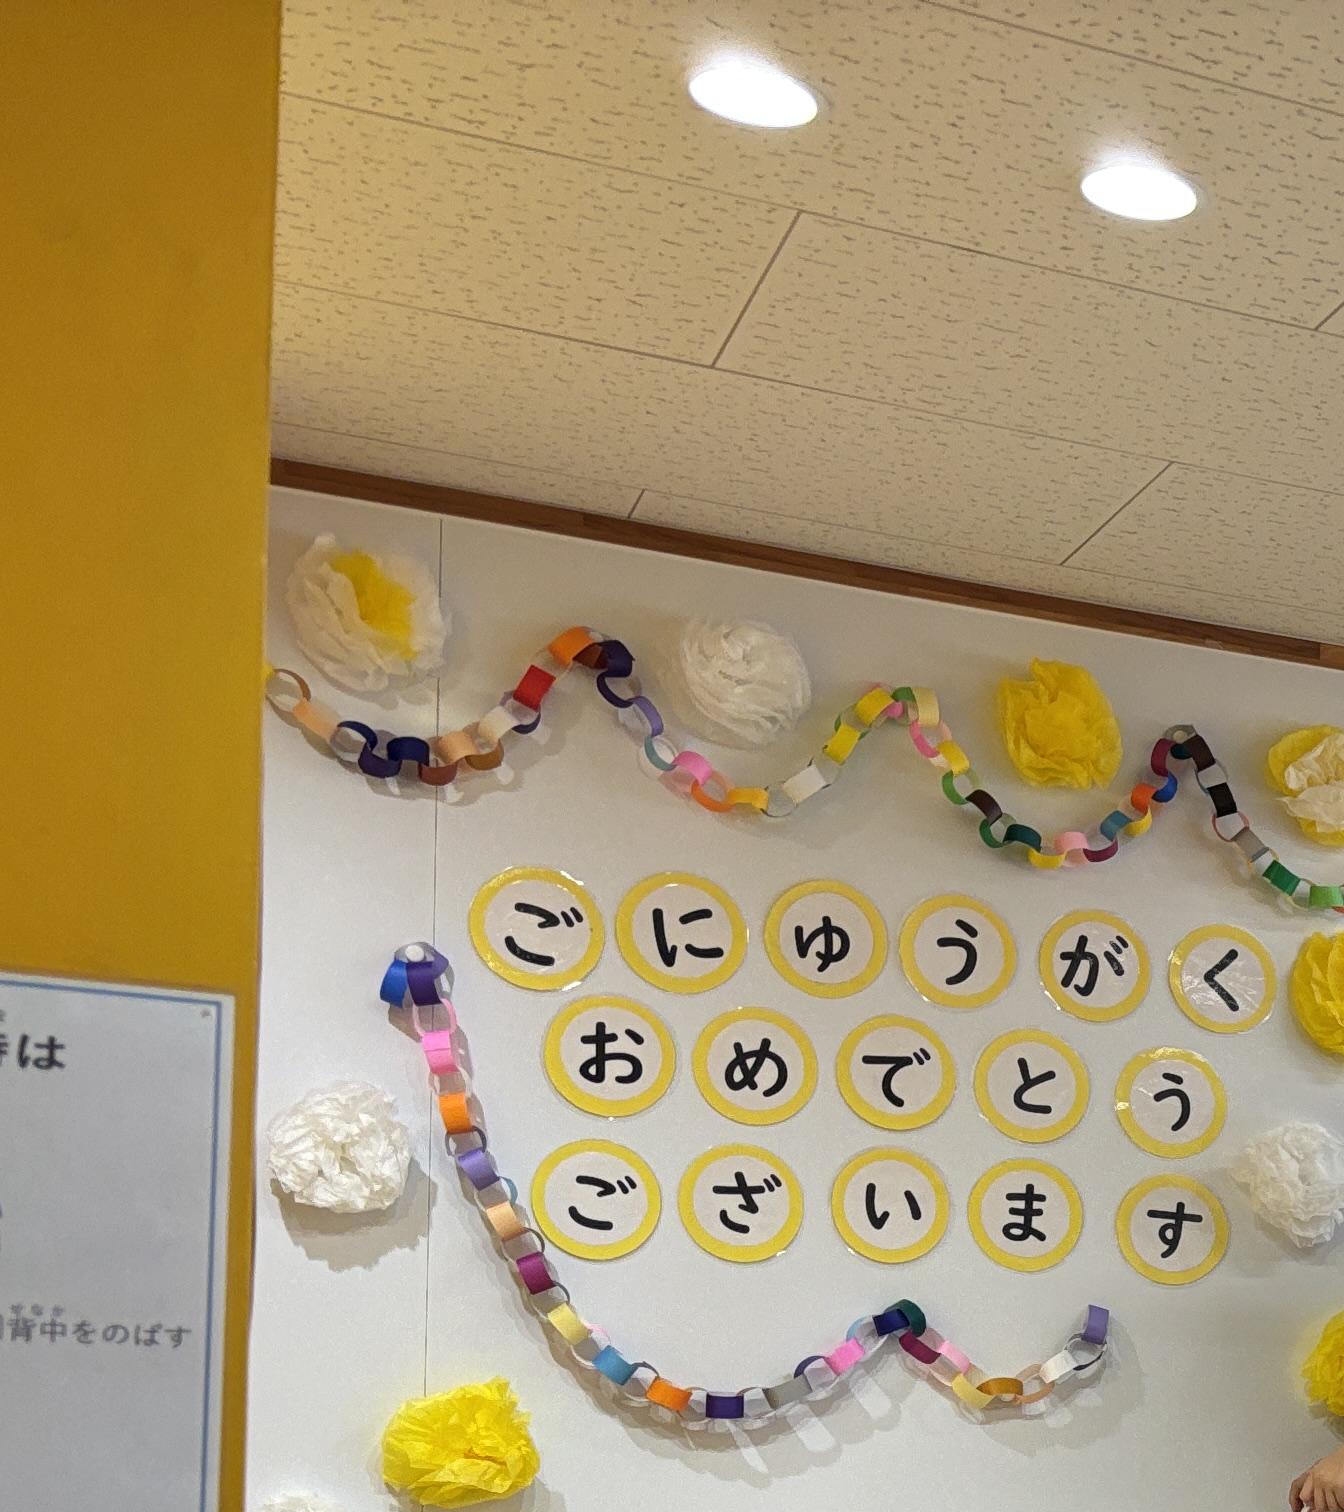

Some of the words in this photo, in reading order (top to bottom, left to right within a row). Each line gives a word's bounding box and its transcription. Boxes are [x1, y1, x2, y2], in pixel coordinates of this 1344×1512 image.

[580, 1020, 1191, 1132] おめでとう
[569, 1171, 1203, 1260] ございます
[0, 1315, 191, 1348] 背中をのばす
